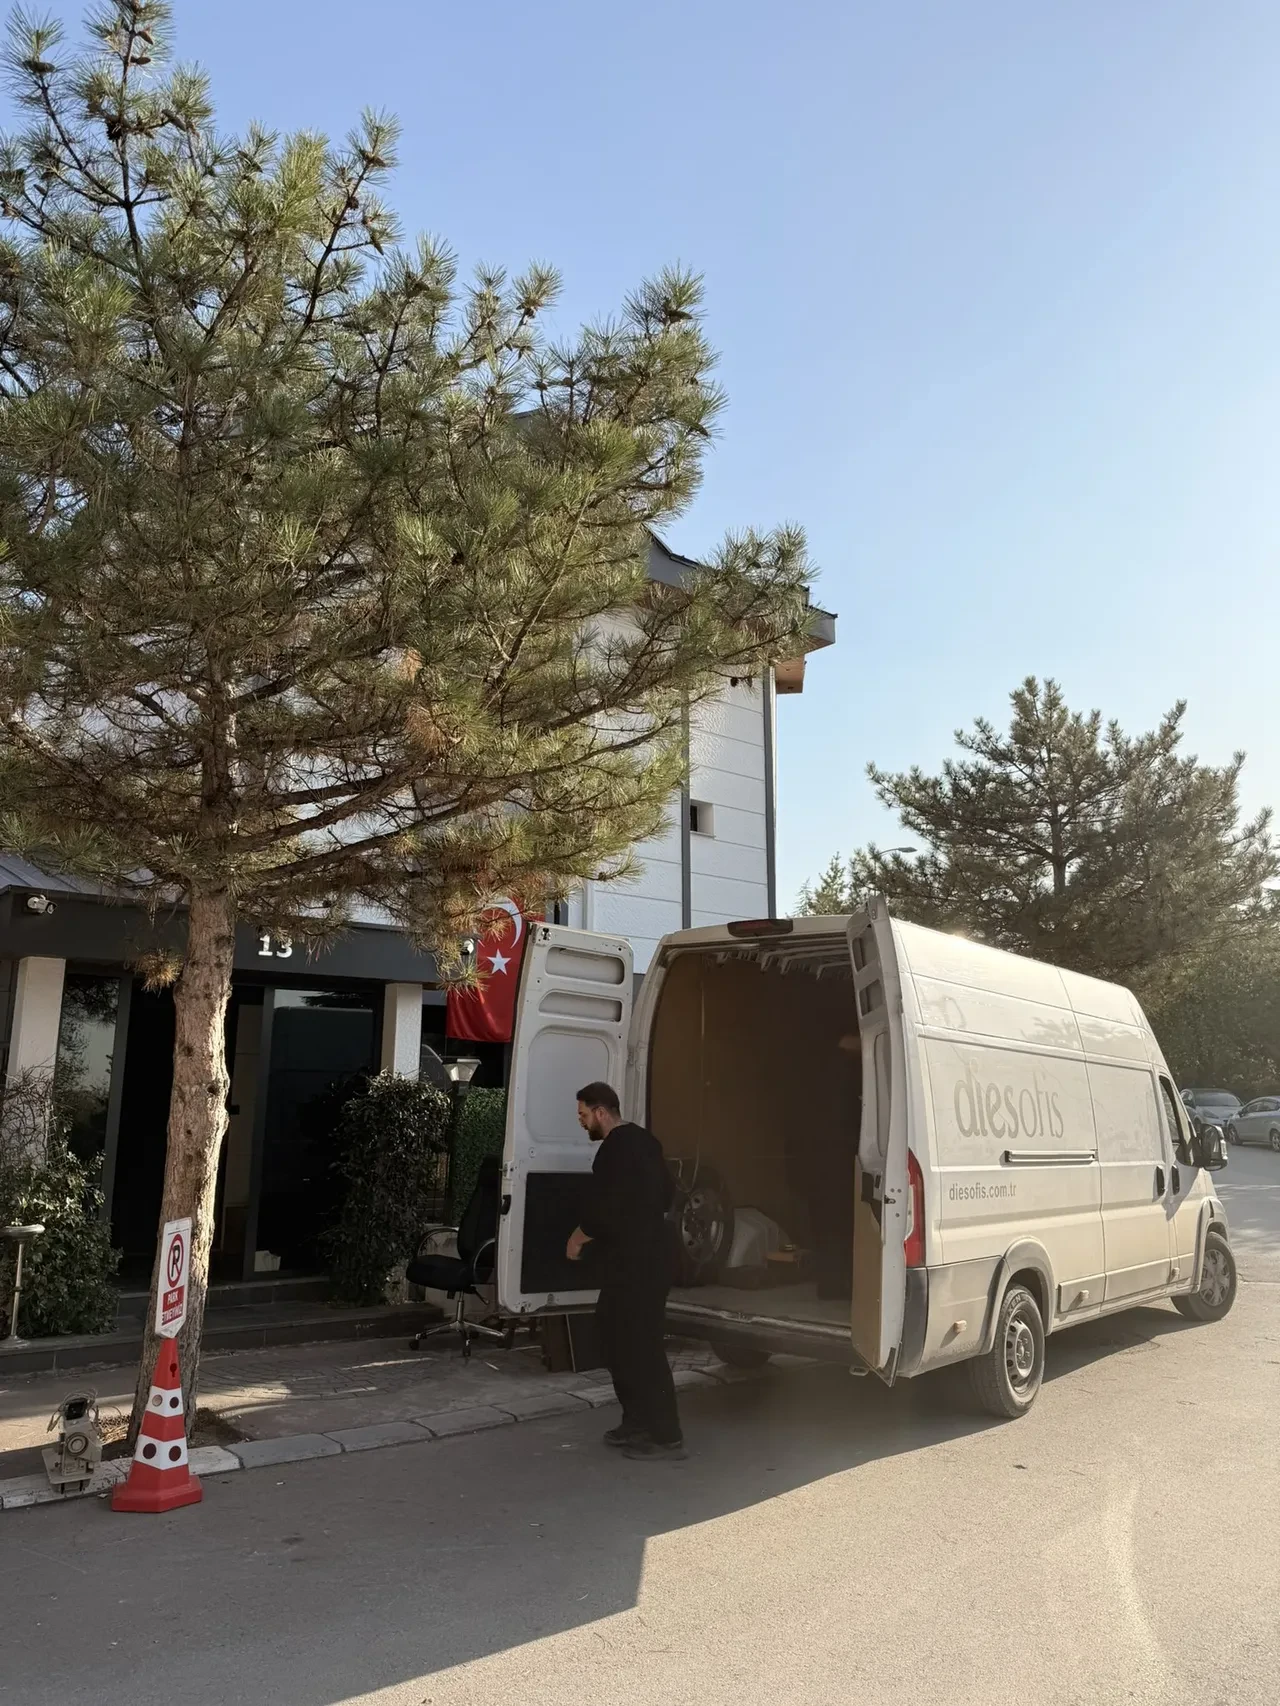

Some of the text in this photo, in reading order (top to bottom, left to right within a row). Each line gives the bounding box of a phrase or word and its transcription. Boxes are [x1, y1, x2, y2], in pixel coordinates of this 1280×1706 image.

[258, 934, 293, 958] 13
[953, 1057, 1064, 1139] diesofis
[949, 1182, 1017, 1201] diesofis.com.tr
[167, 1291, 179, 1304] PARK
